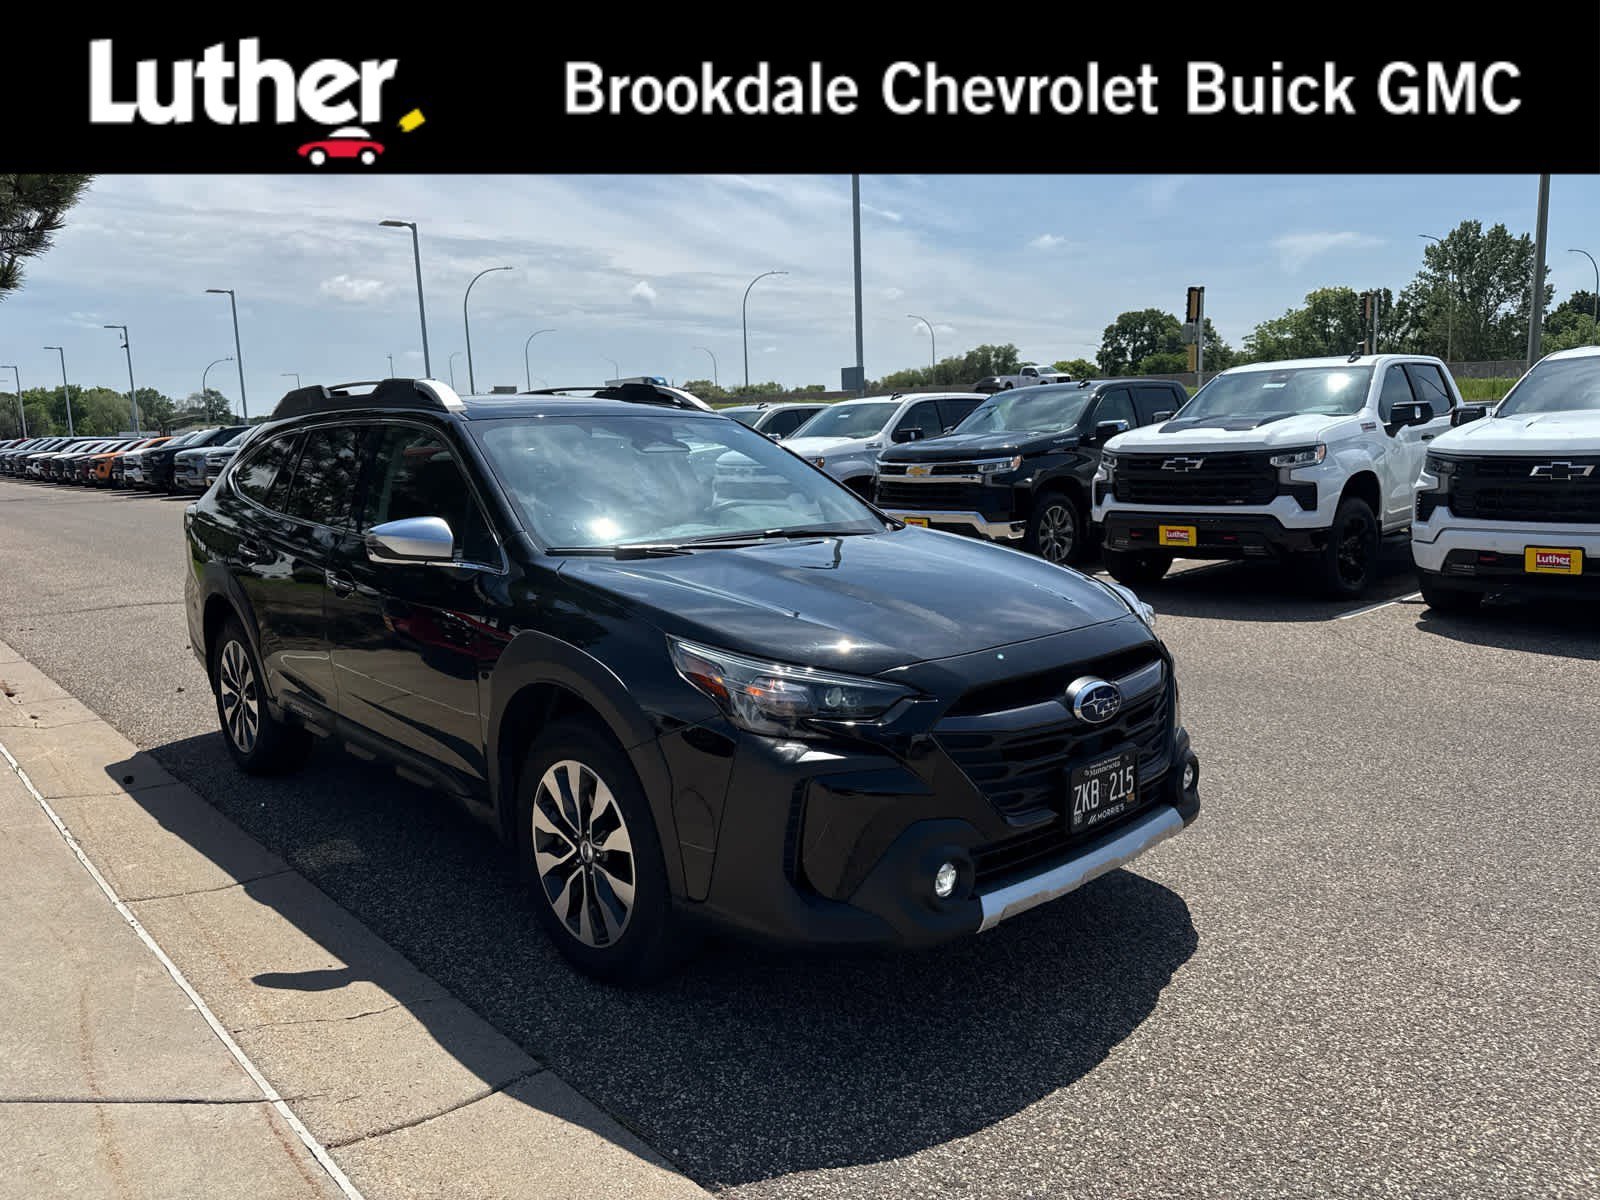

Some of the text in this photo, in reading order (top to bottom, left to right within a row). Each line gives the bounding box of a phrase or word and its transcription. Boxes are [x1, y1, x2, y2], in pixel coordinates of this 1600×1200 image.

[1536, 554, 1570, 565] Luther
[1073, 765, 1134, 816] ZKB 215
